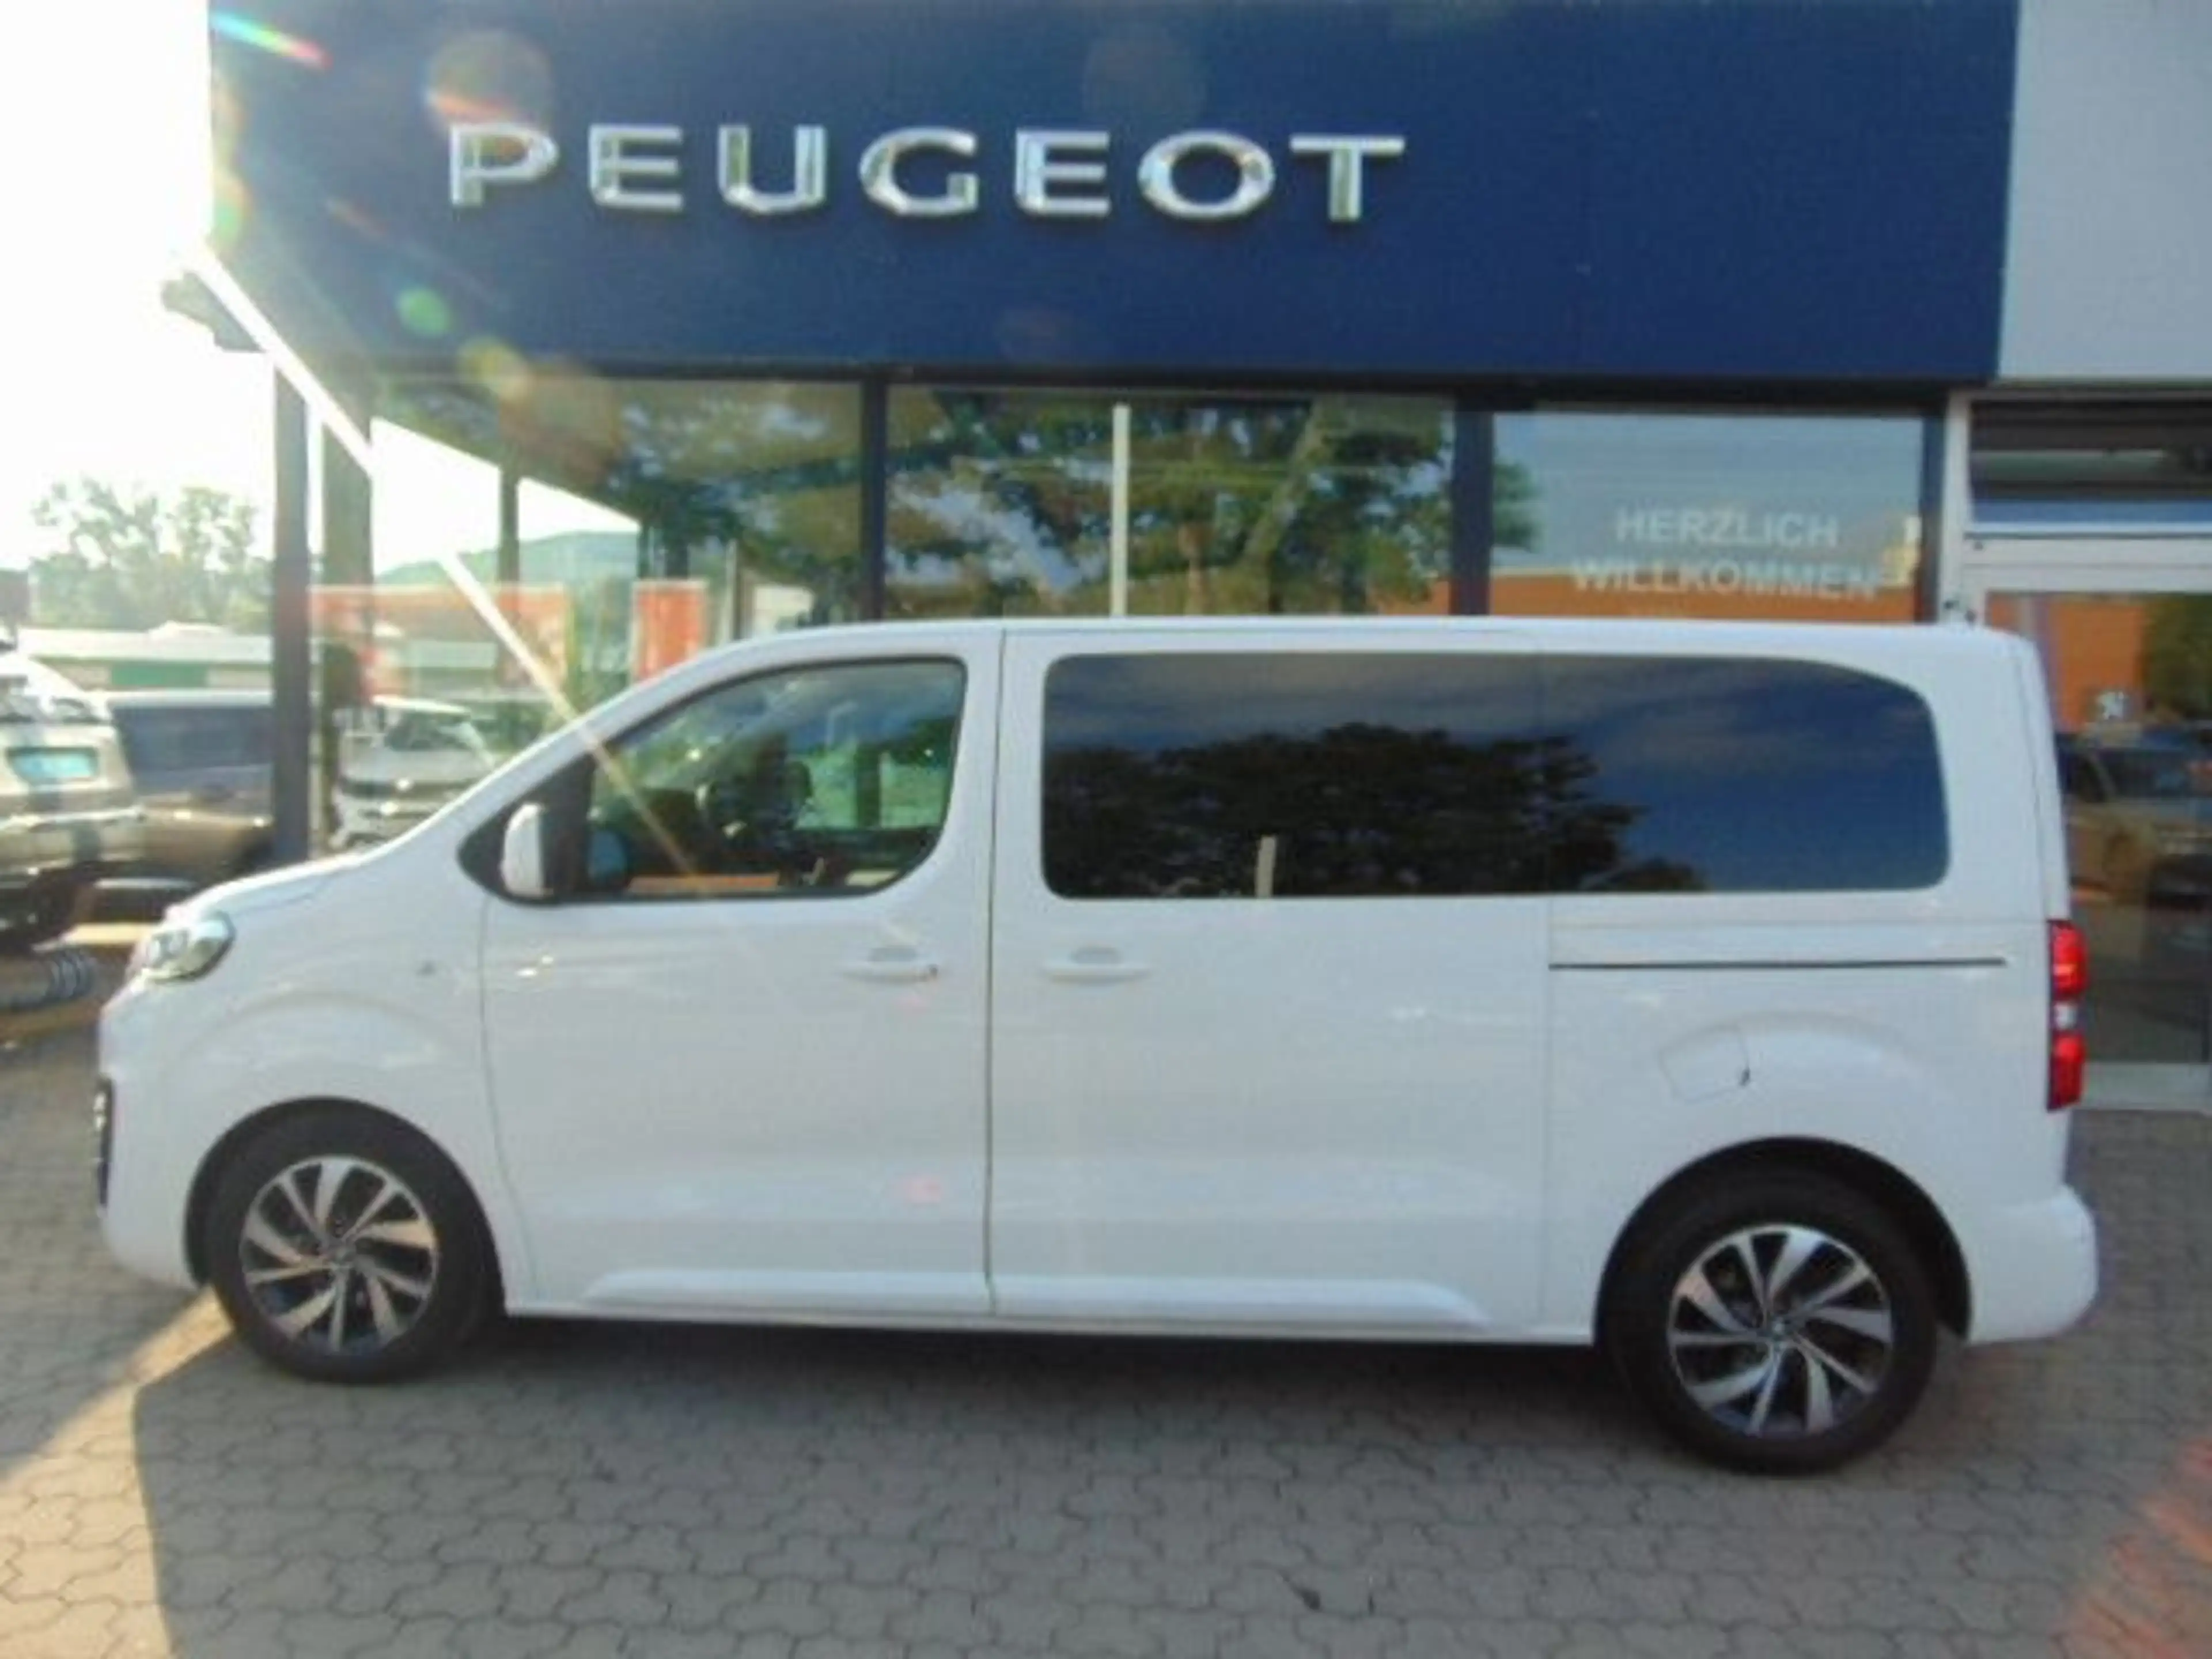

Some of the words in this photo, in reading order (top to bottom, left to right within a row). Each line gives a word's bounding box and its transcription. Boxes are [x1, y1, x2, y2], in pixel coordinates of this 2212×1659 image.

[449, 123, 1406, 222] PEUGEOT
[1615, 508, 1839, 546] HERZLICH
[1571, 559, 1879, 600] WILLKOMMEN
